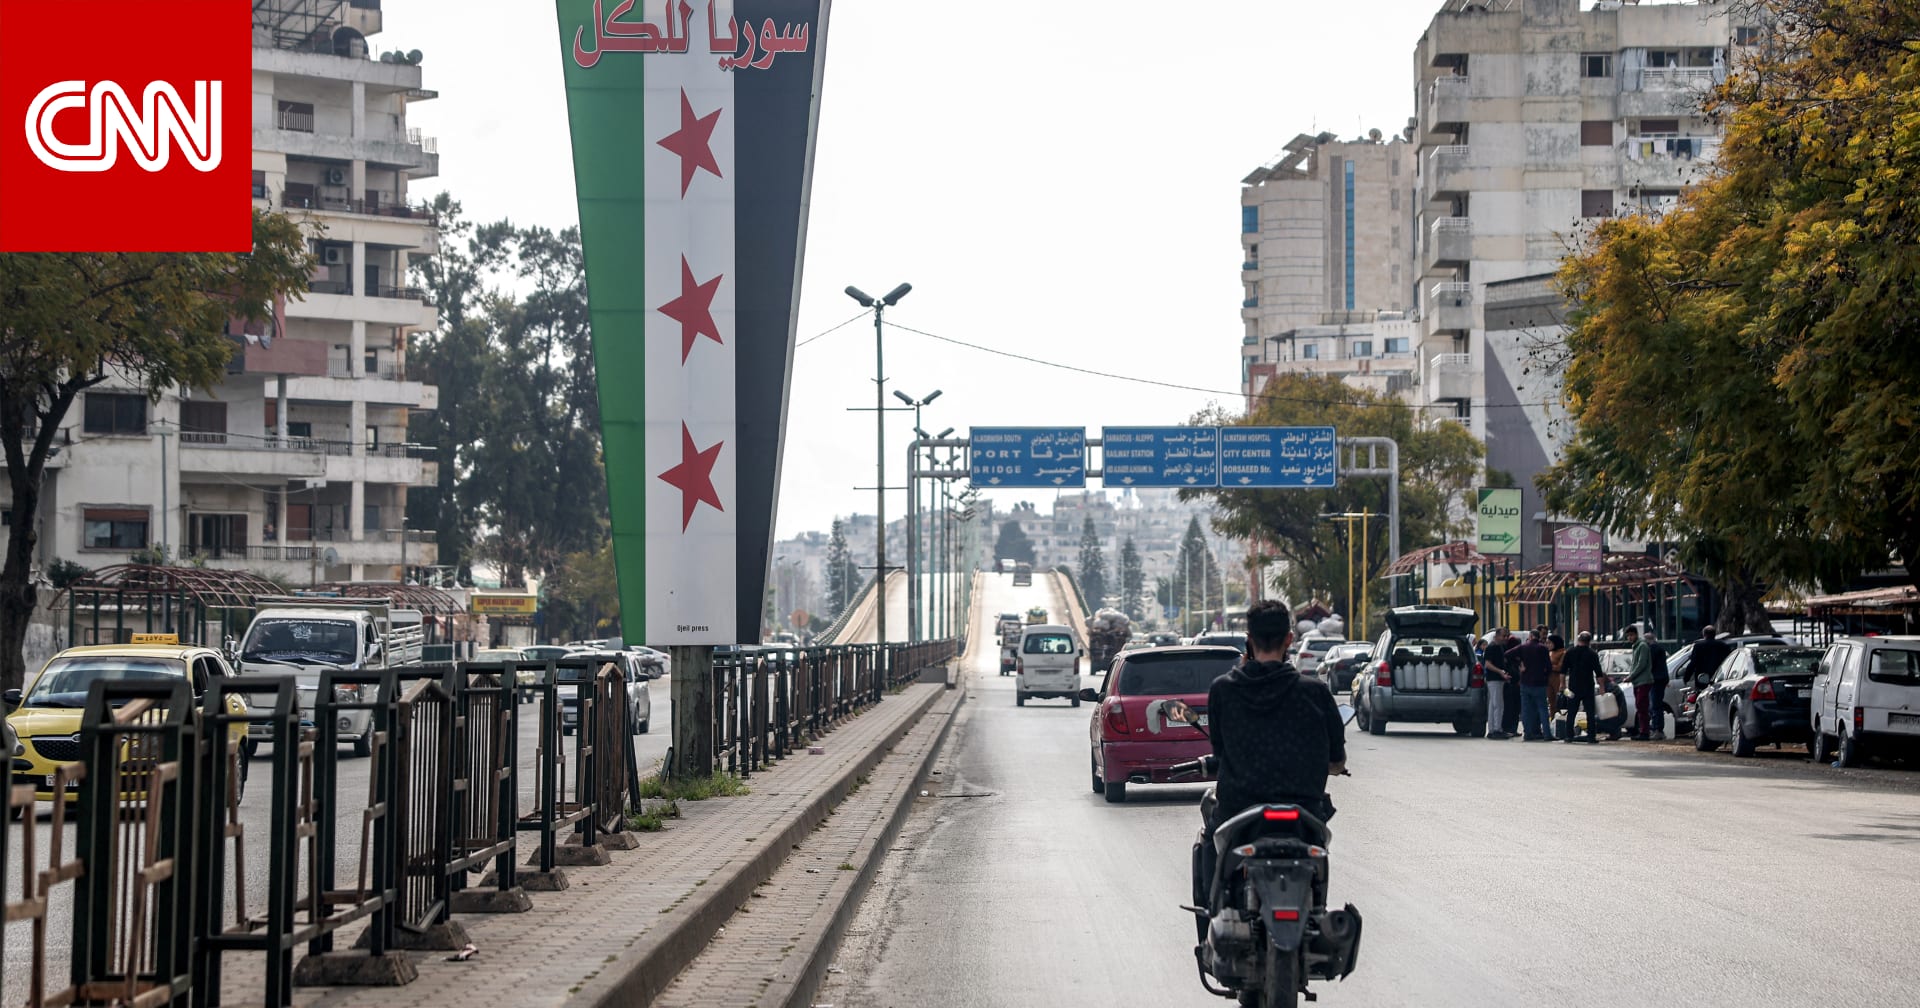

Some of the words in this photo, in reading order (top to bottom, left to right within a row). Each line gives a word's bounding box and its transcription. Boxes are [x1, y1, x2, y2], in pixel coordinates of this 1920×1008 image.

[573, 0, 694, 68] للكل
[708, 0, 809, 70] سوريا
[1055, 432, 1081, 446] الكورنيش
[1135, 434, 1154, 442] ALEPPO
[1163, 433, 1187, 445] حلب
[1192, 430, 1215, 445] دمشق
[1248, 434, 1271, 442] HOSPITAL
[1280, 432, 1307, 445] الوطني
[973, 450, 1021, 458] PORT
[1106, 450, 1130, 458] RAILWAY
[1130, 450, 1154, 458] STATION
[1164, 447, 1192, 461] القطار
[1192, 445, 1215, 457] محطة
[1223, 449, 1240, 458] CITY
[1242, 449, 1271, 458] CENTER
[973, 466, 1021, 474] BRIDGE
[1033, 466, 1081, 478] جسر
[1223, 465, 1259, 473] BORSAEED
[1316, 461, 1333, 476] شارع
[1481, 504, 1519, 518] صيدلية
[1557, 536, 1600, 553] صيدلية
